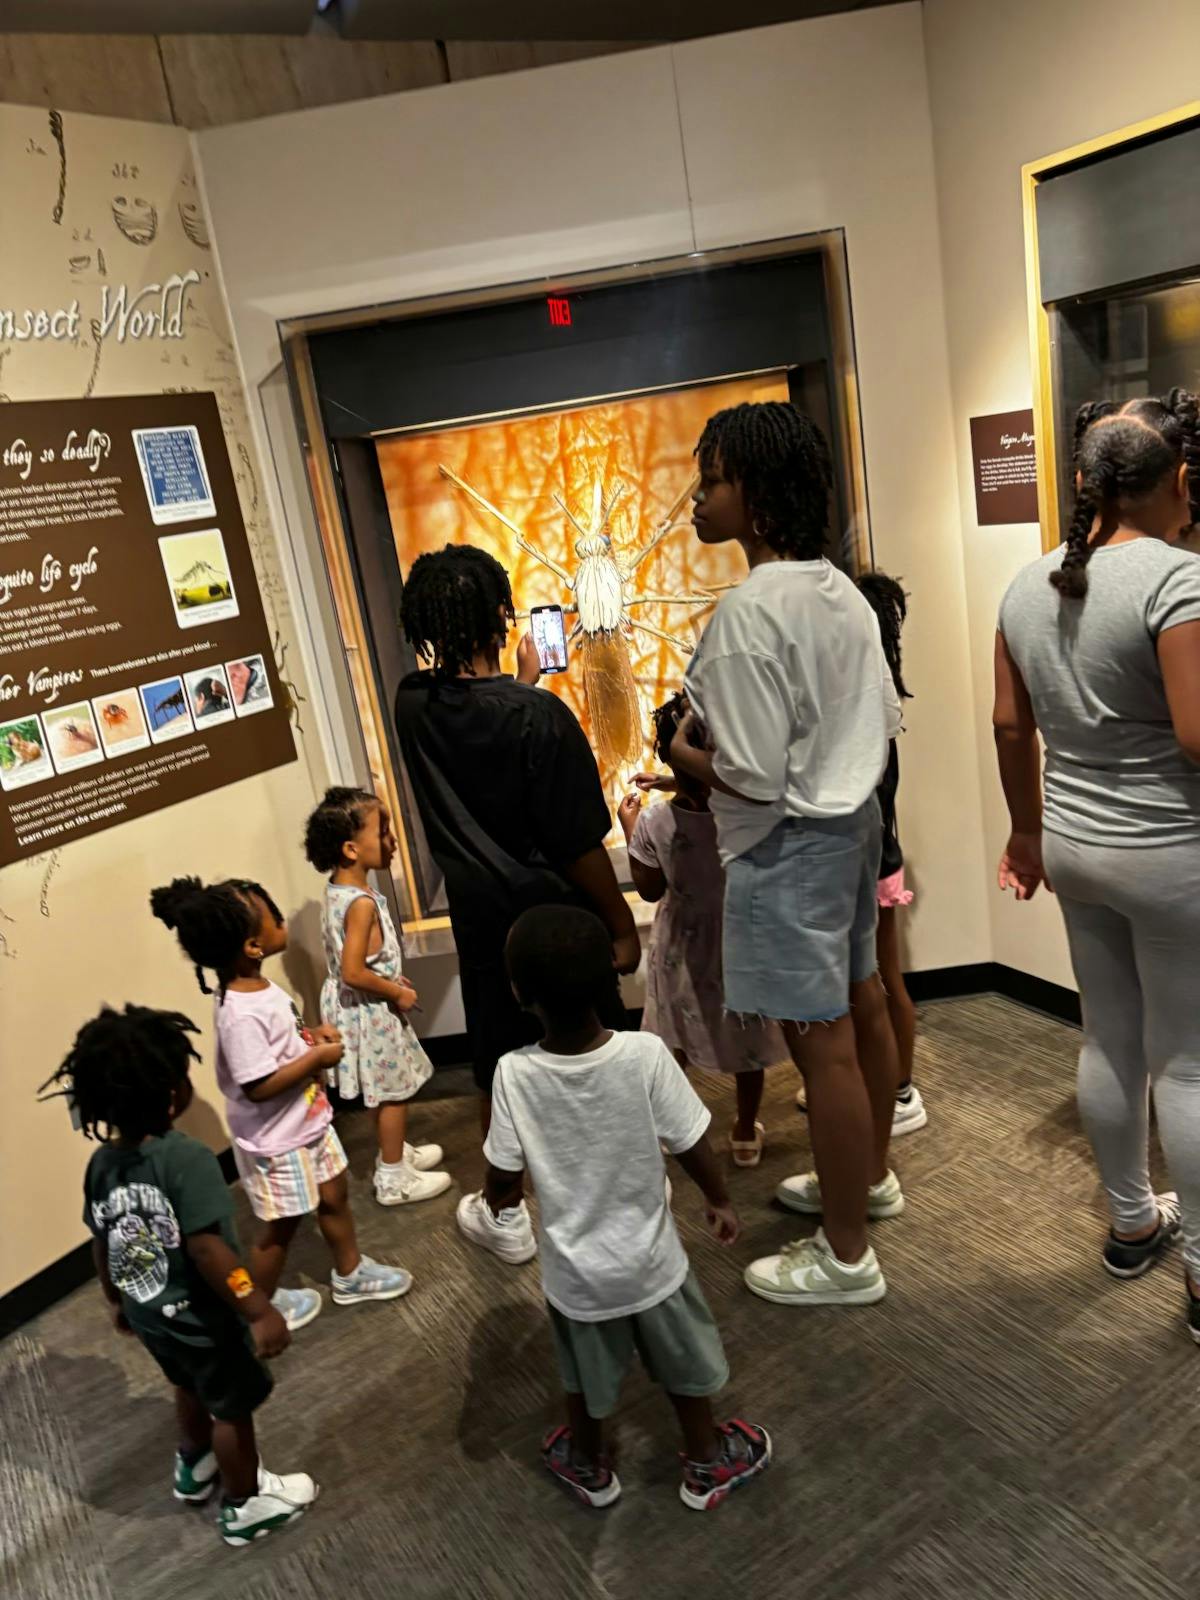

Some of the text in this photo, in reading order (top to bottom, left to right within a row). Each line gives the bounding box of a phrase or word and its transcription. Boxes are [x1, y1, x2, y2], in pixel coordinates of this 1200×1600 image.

[100, 270, 199, 342] World
[3, 439, 32, 480] they
[40, 449, 54, 462] so
[18, 830, 43, 847] Learn
[42, 823, 65, 838] more
[64, 819, 76, 830] on
[75, 814, 90, 826] the
